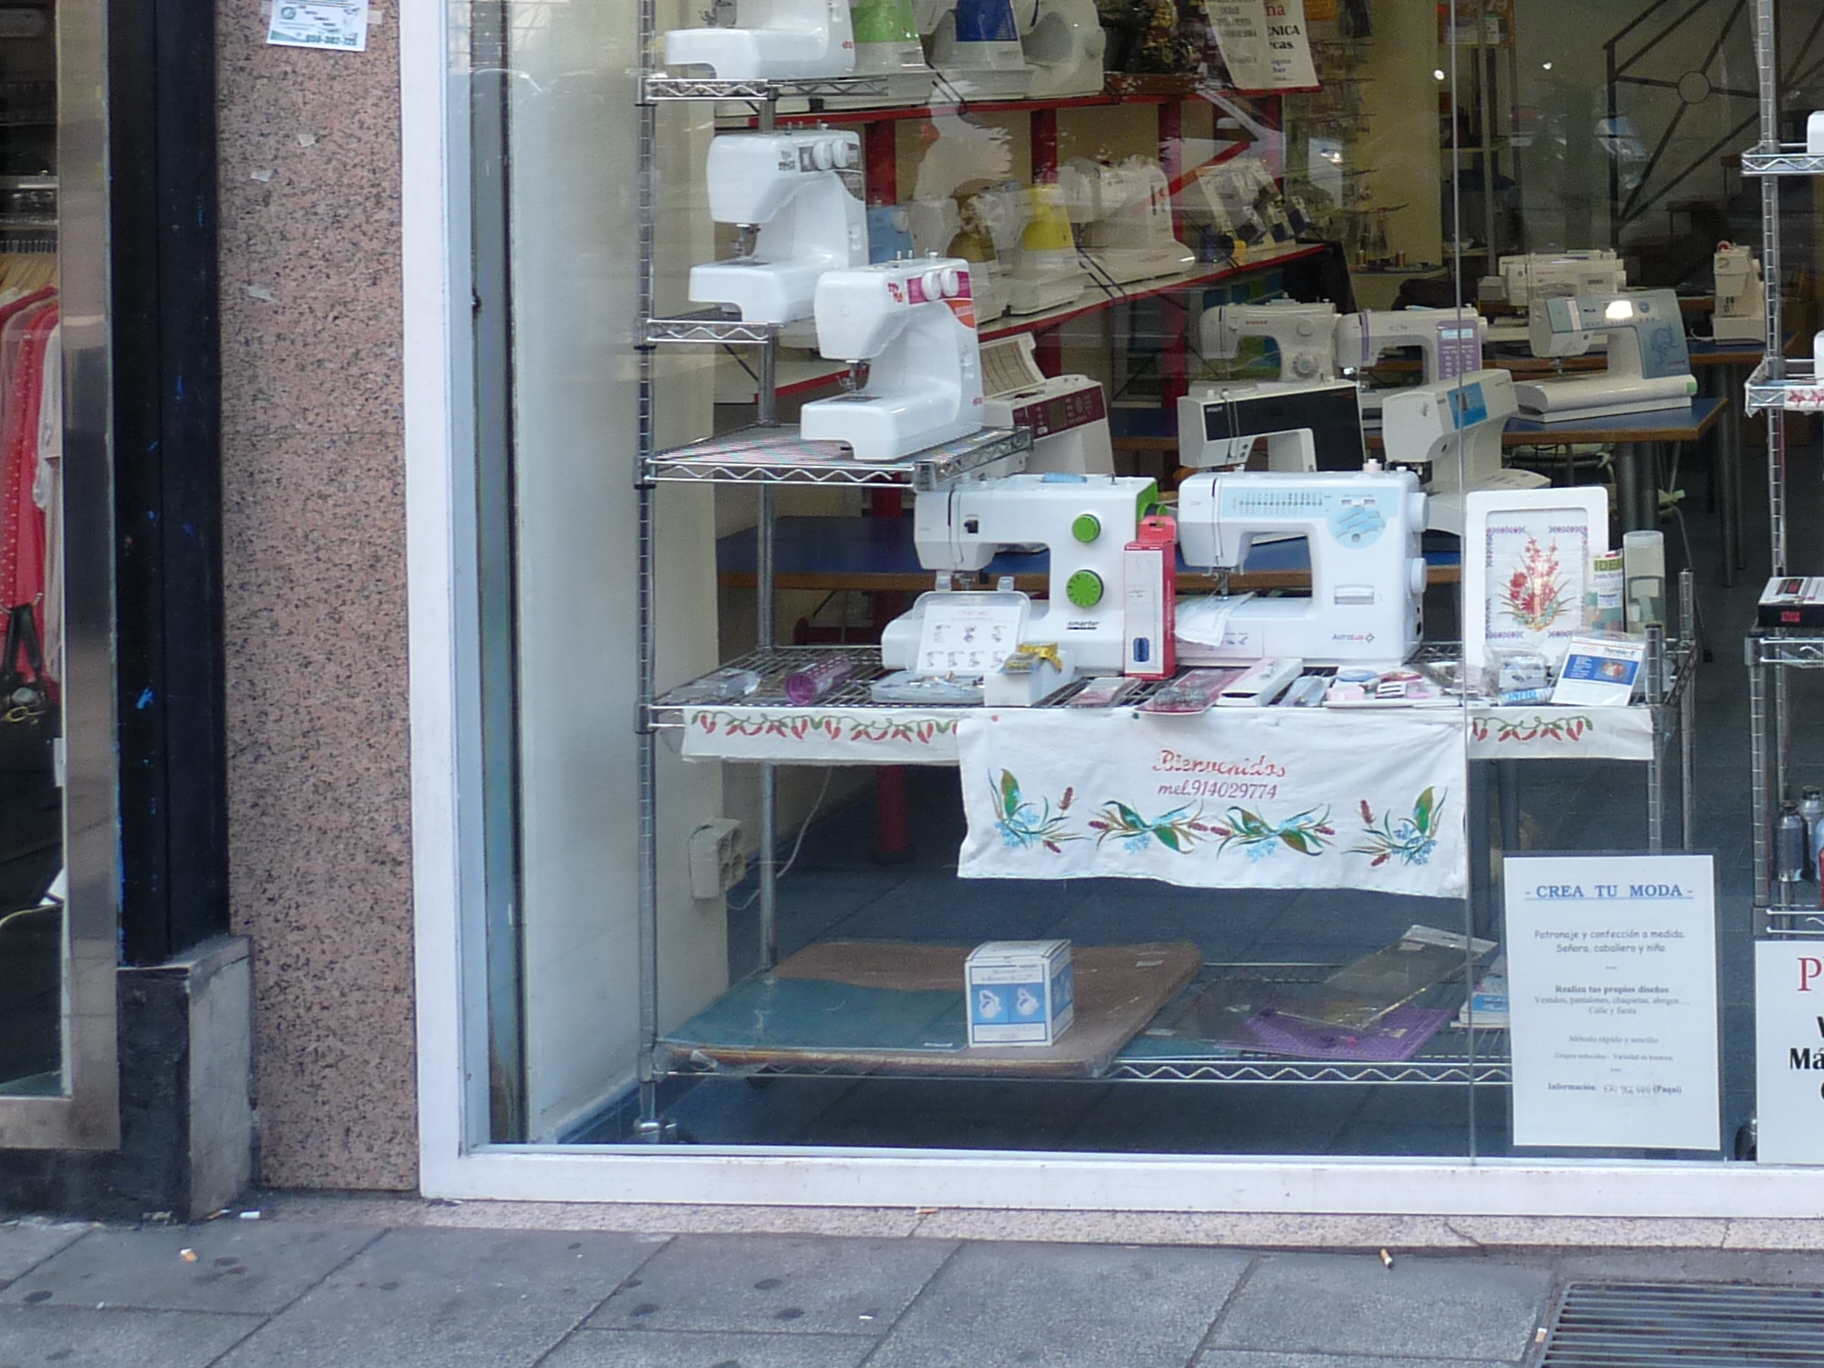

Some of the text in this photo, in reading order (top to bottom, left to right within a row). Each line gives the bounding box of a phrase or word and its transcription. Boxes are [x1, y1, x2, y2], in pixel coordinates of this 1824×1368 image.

[1152, 749, 1287, 778] Bienvenidos
[1535, 884, 1682, 898] CREA TU MODA
[1534, 929, 1579, 941] Patronaje
[1581, 933, 1587, 942] y
